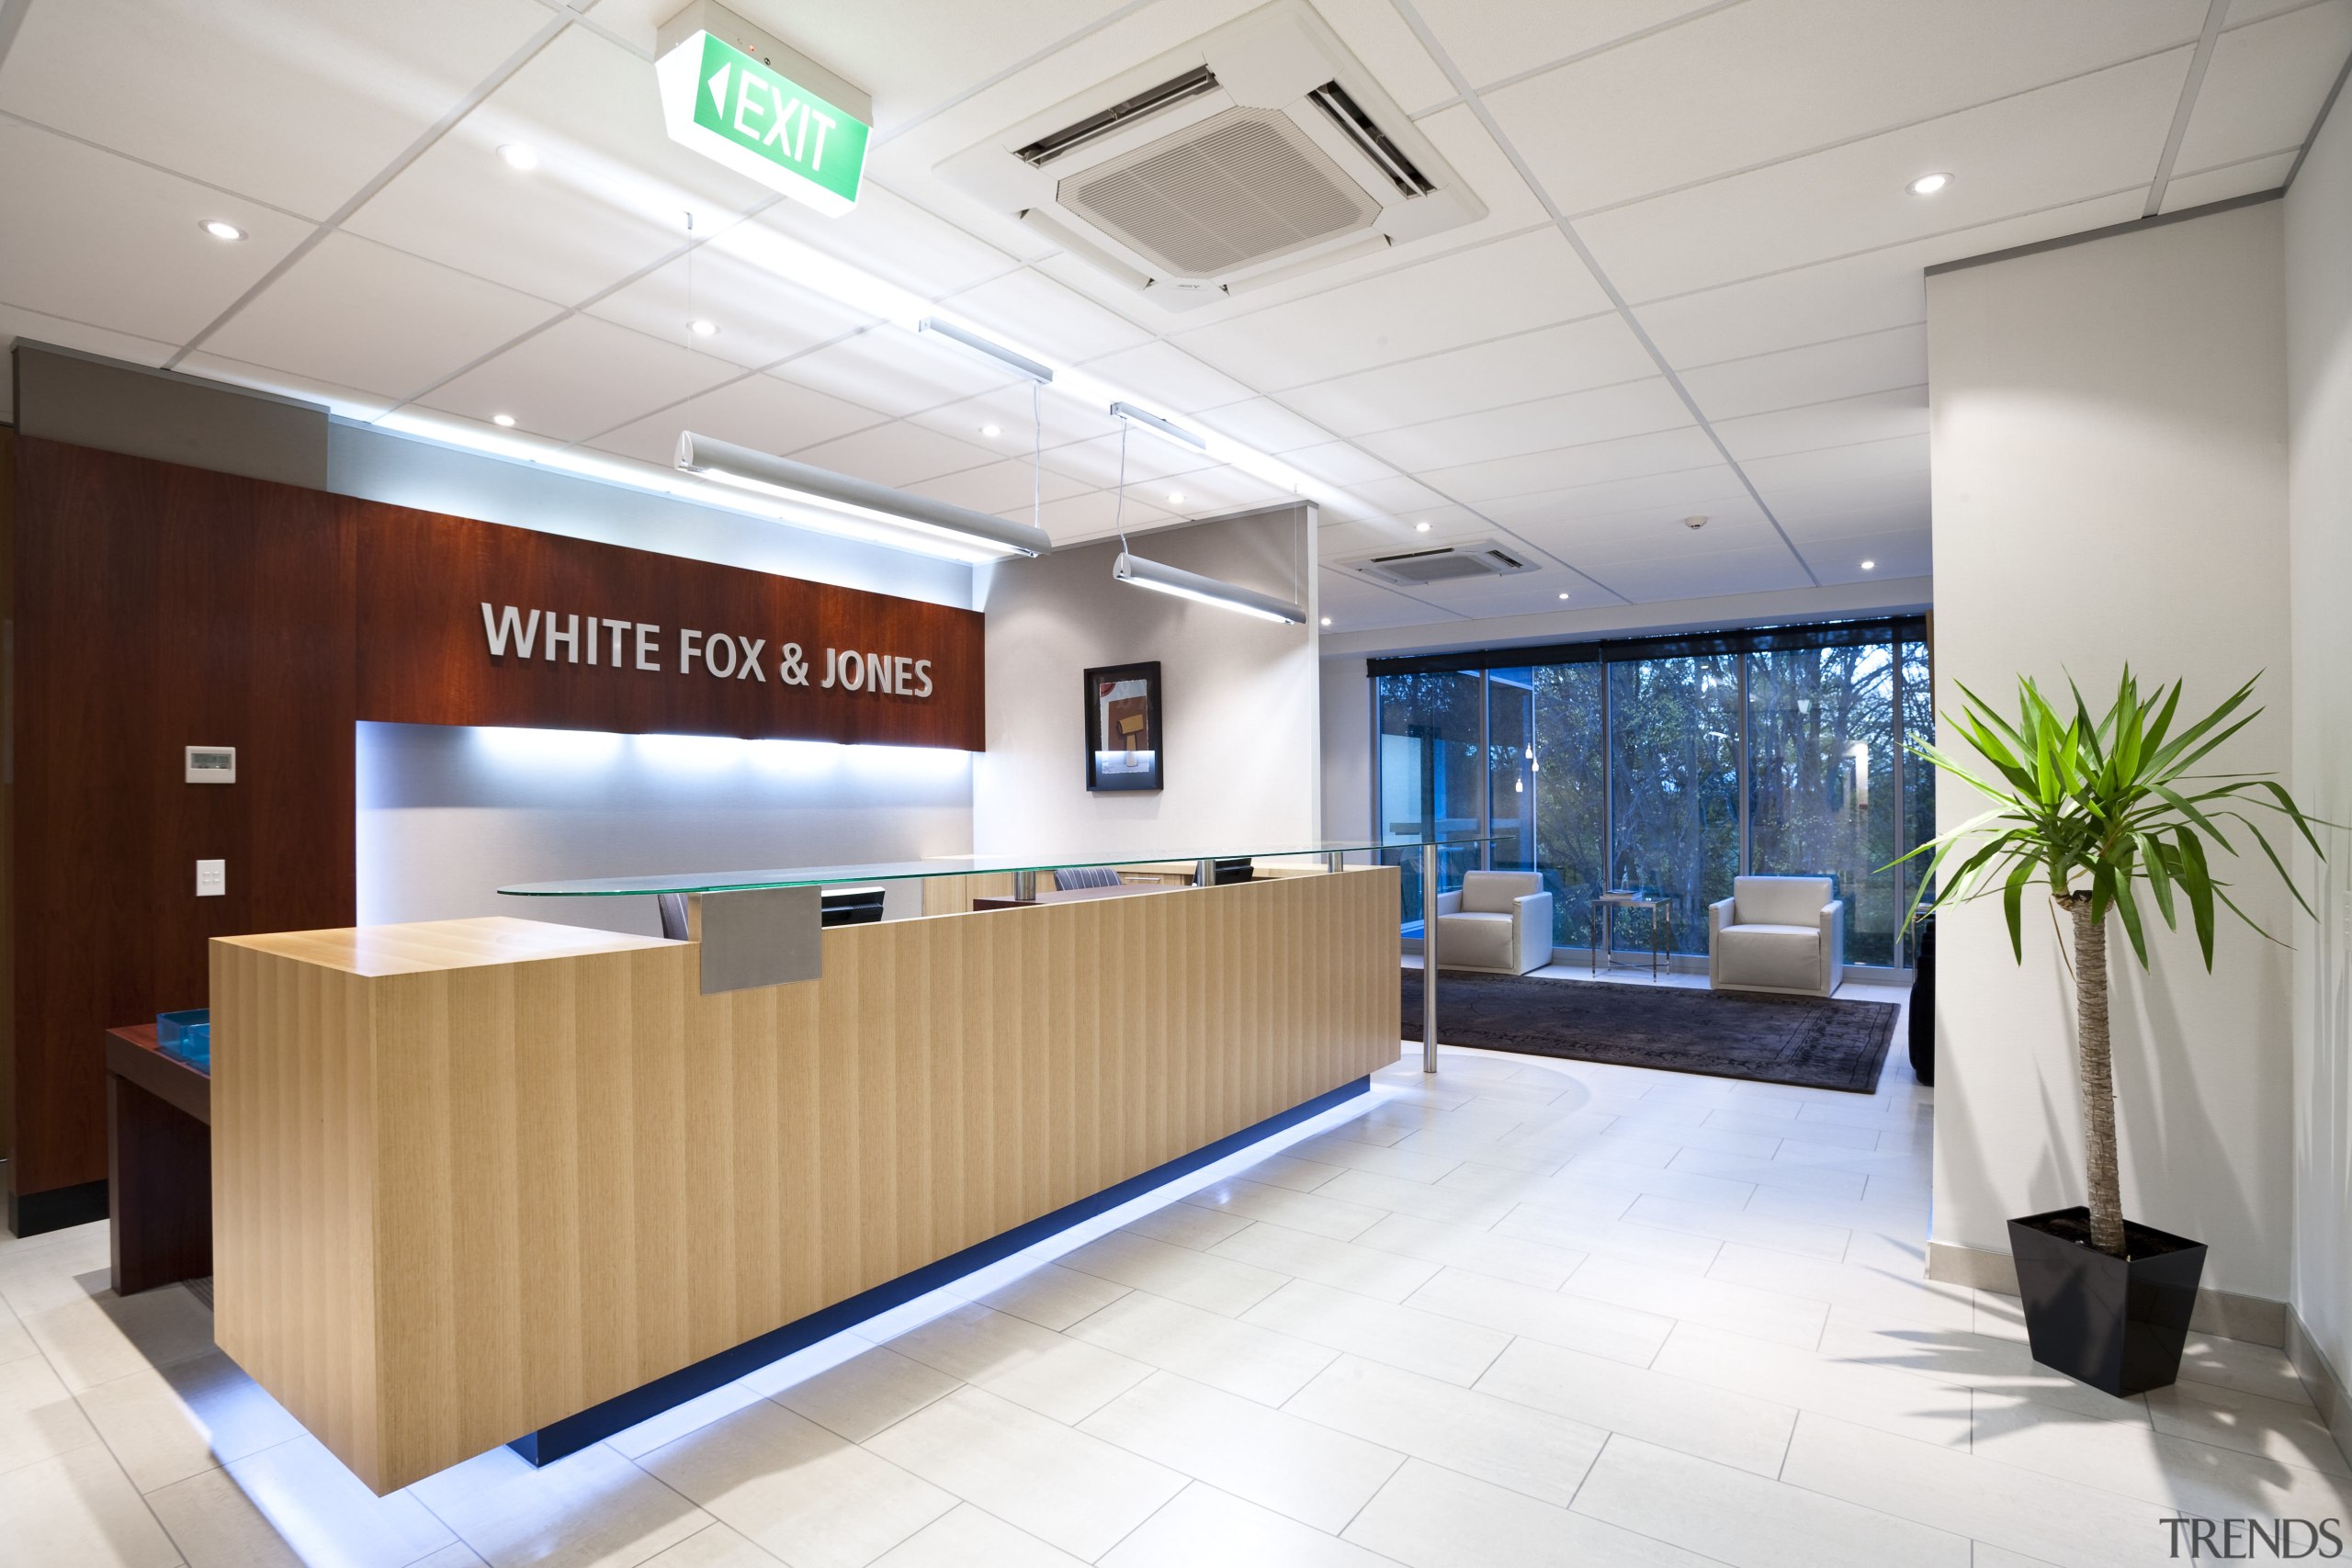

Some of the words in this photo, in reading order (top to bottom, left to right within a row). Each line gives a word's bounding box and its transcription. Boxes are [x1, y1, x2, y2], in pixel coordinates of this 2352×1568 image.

[733, 70, 835, 172] EXIT
[481, 602, 661, 671] WHITE
[680, 628, 766, 682] FOX
[779, 642, 809, 686] &
[820, 647, 933, 698] JONES
